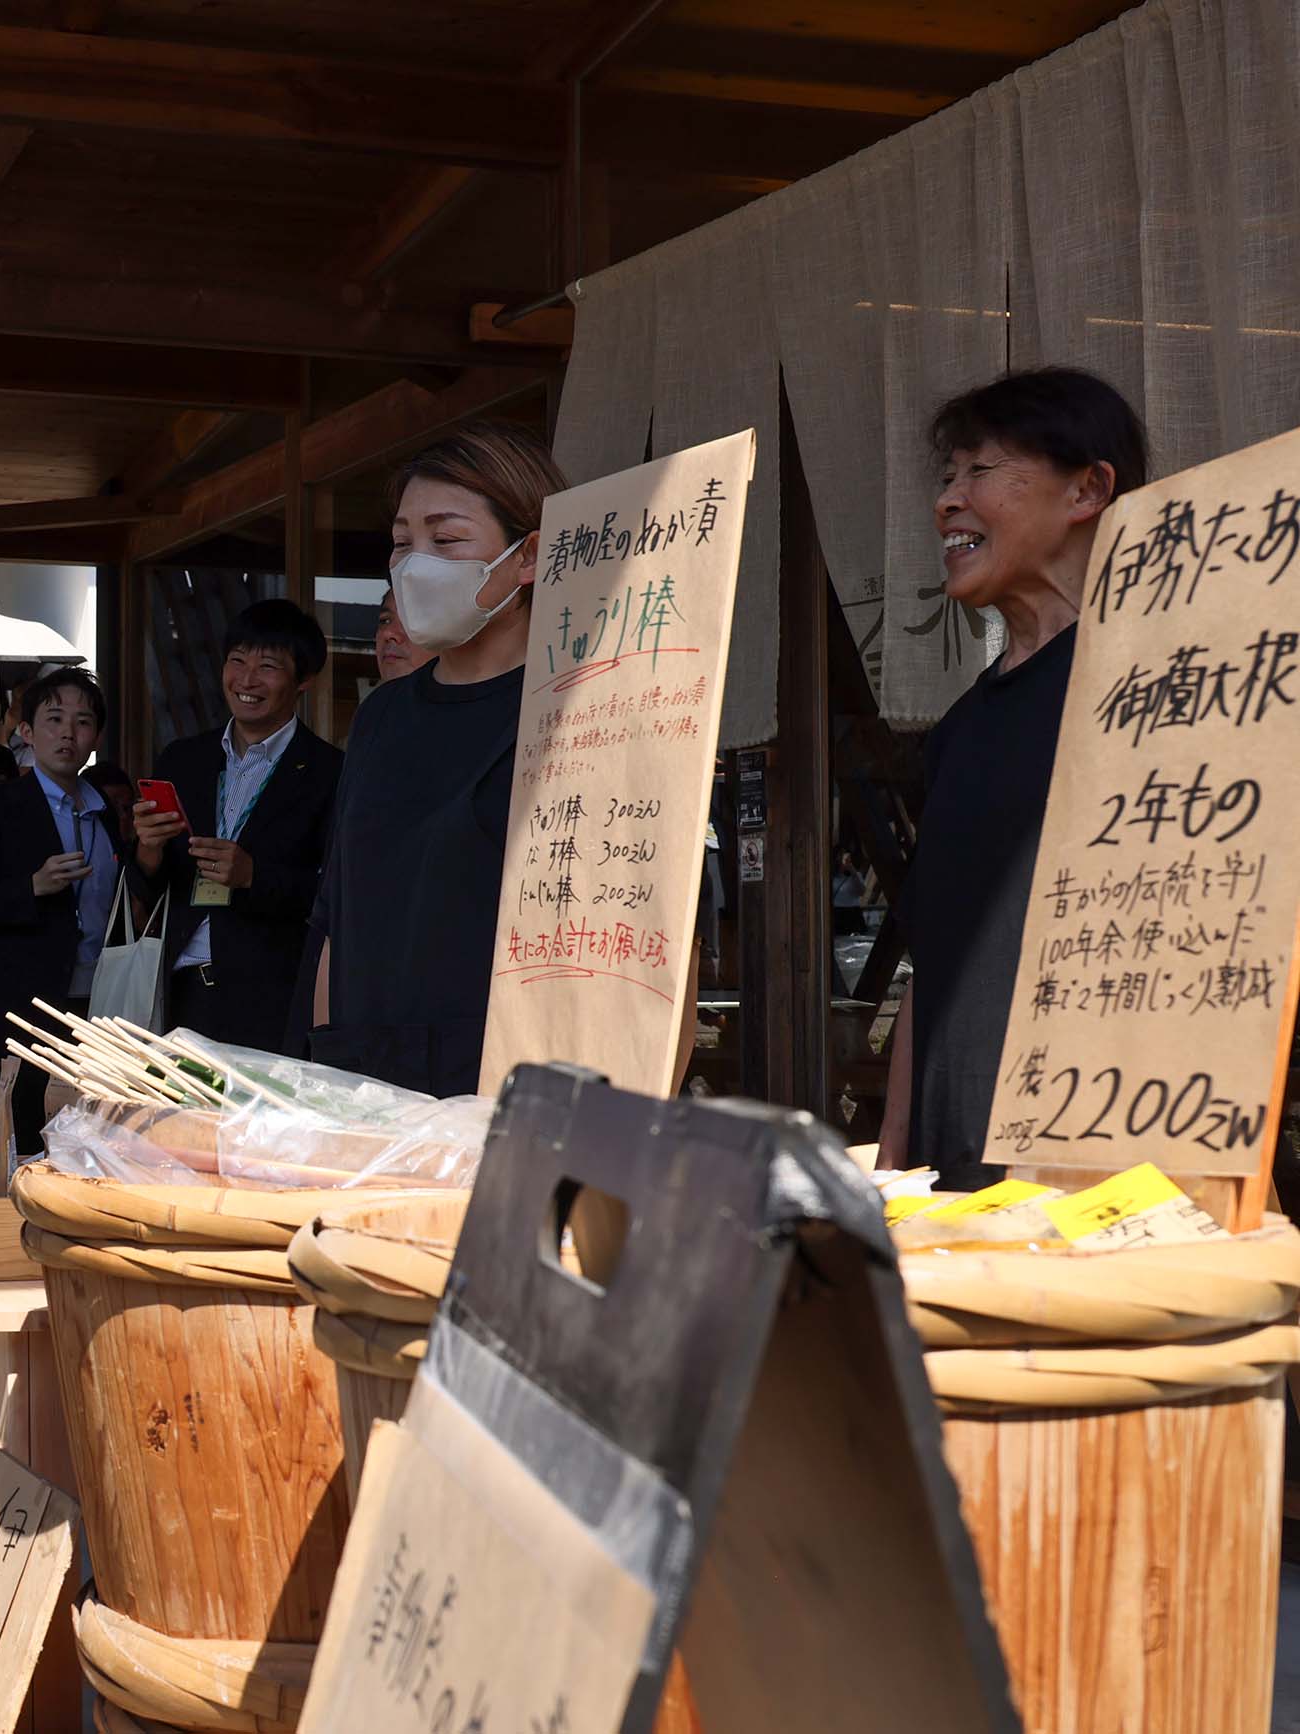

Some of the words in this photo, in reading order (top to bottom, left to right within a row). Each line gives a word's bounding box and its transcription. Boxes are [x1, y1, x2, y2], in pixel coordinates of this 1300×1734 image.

[543, 478, 726, 586] 漬物屋のぬか漬
[548, 575, 686, 673] きゅうり棒
[530, 794, 588, 838] きゅうり棒
[1088, 763, 1263, 848] 2年もの
[1044, 850, 1267, 919] 昔からの伝統を守り
[1039, 905, 1268, 972] 100年余使い込んだ
